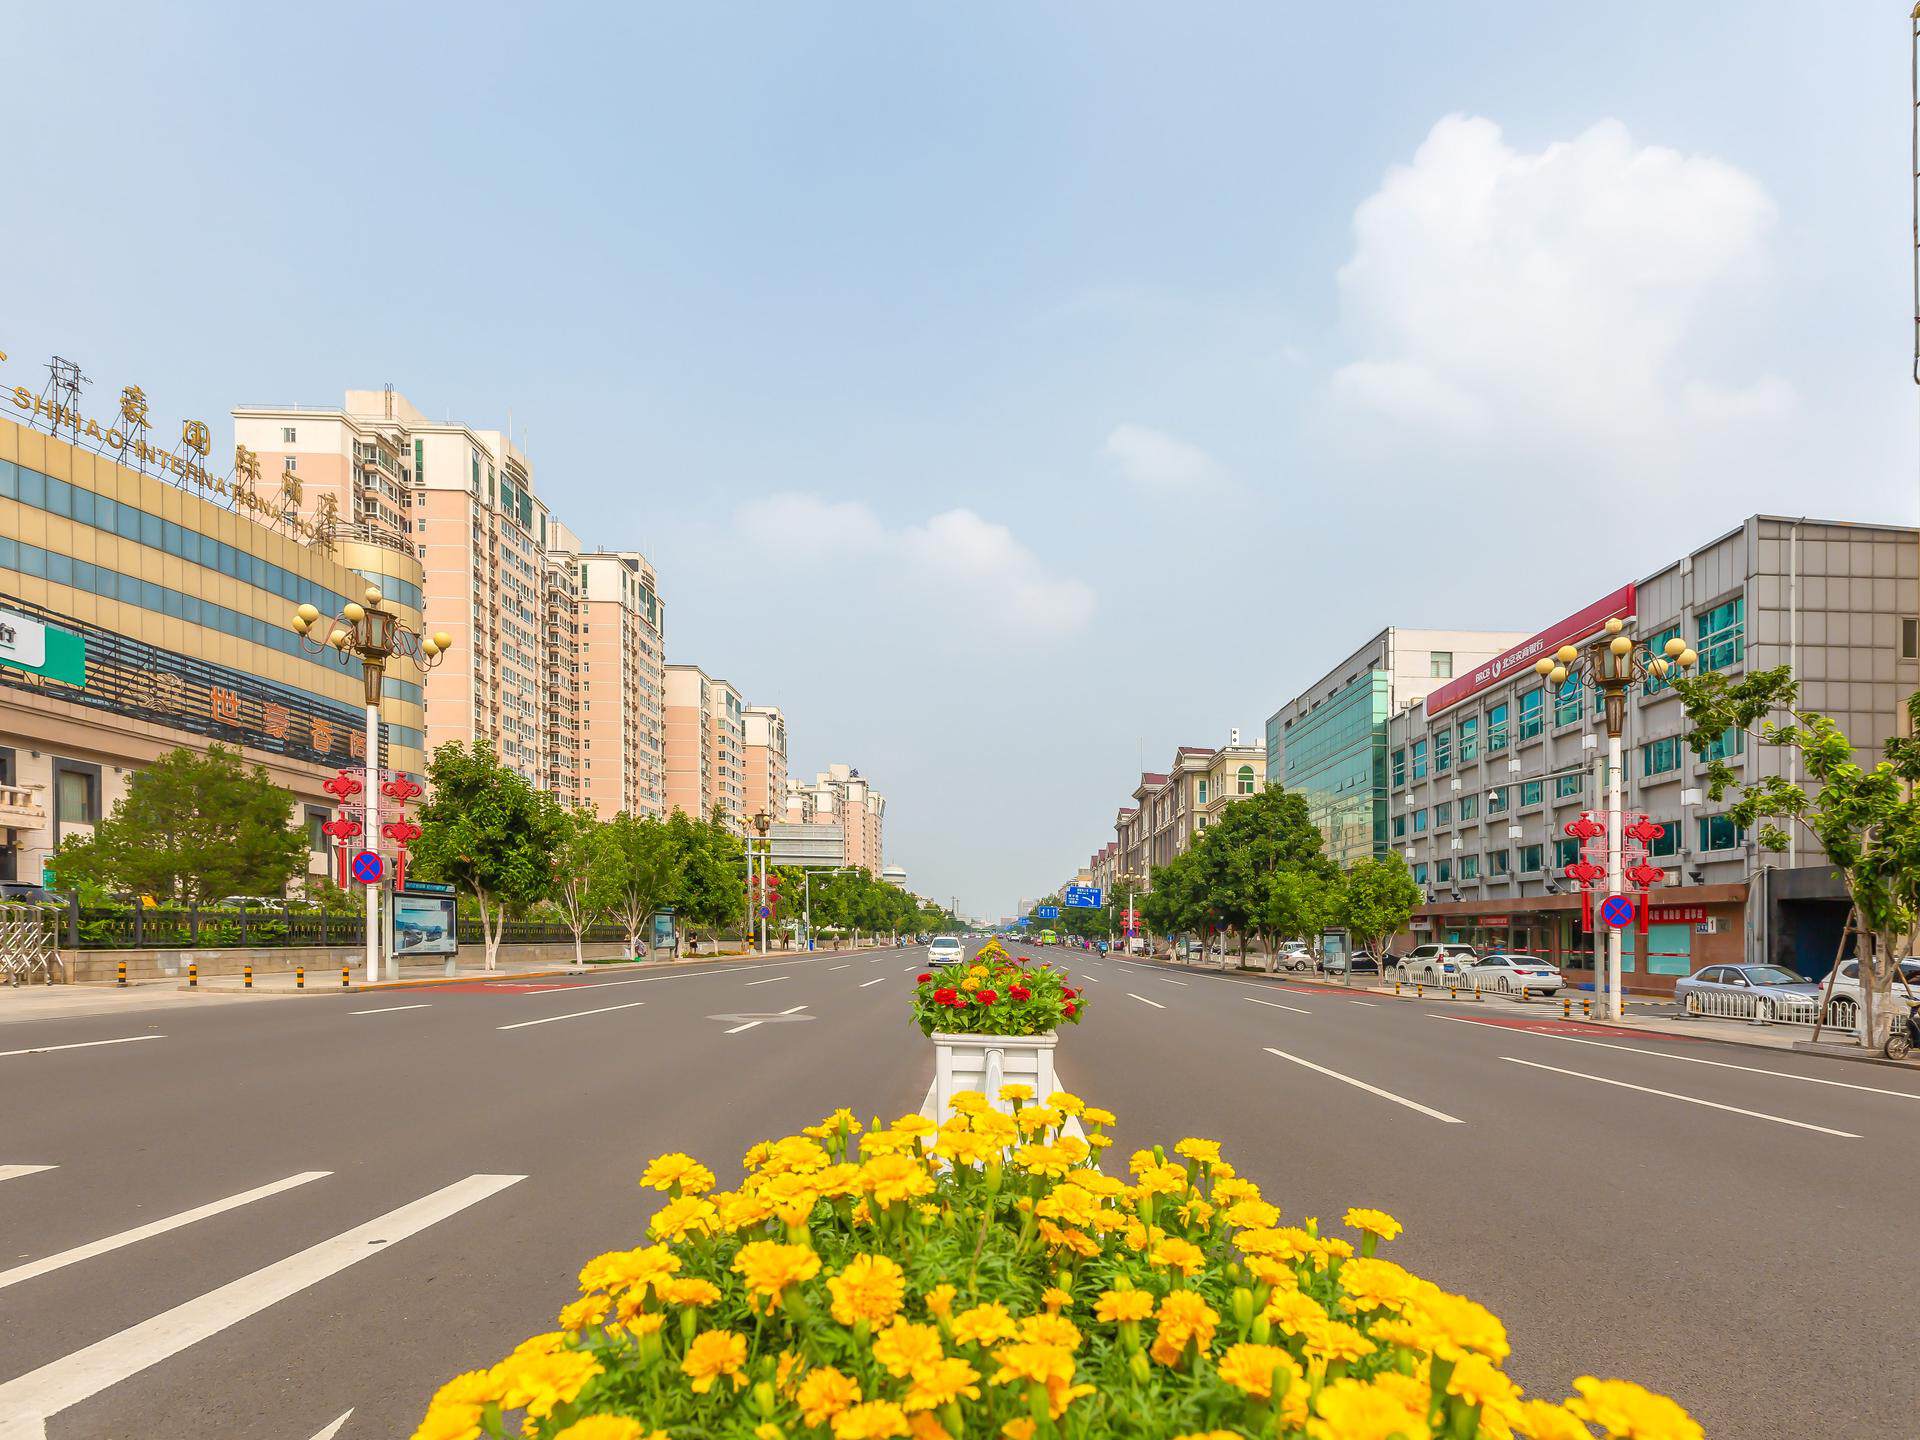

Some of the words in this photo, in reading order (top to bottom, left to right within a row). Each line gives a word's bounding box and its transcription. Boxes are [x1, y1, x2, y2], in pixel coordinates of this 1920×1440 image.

[12, 386, 124, 450] SHIHAO
[134, 438, 284, 523] INTERNATIONA
[1475, 668, 1491, 684] BRCB
